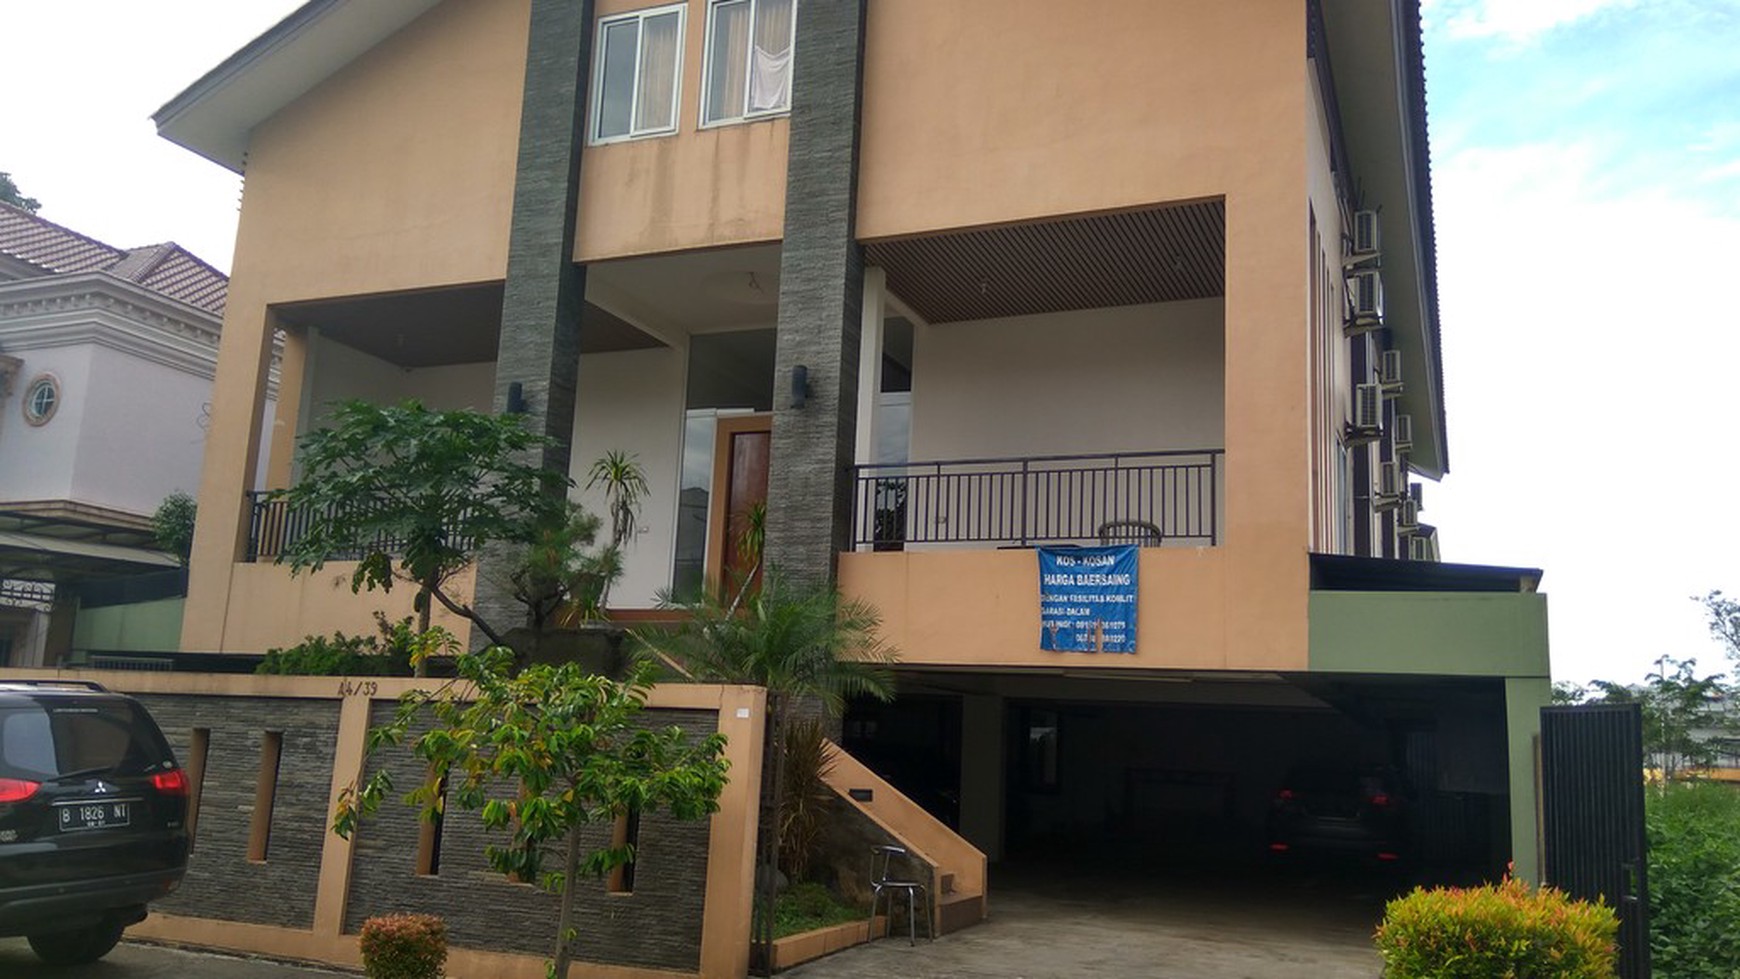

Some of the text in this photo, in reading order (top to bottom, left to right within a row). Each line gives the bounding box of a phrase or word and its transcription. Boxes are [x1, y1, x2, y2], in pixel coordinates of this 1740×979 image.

[1056, 556, 1076, 567] KOS
[1082, 555, 1115, 567] KOSAN
[1043, 573, 1131, 586] HARGA BAERSAING
[62, 808, 71, 823] B
[80, 805, 105, 821] 1826
